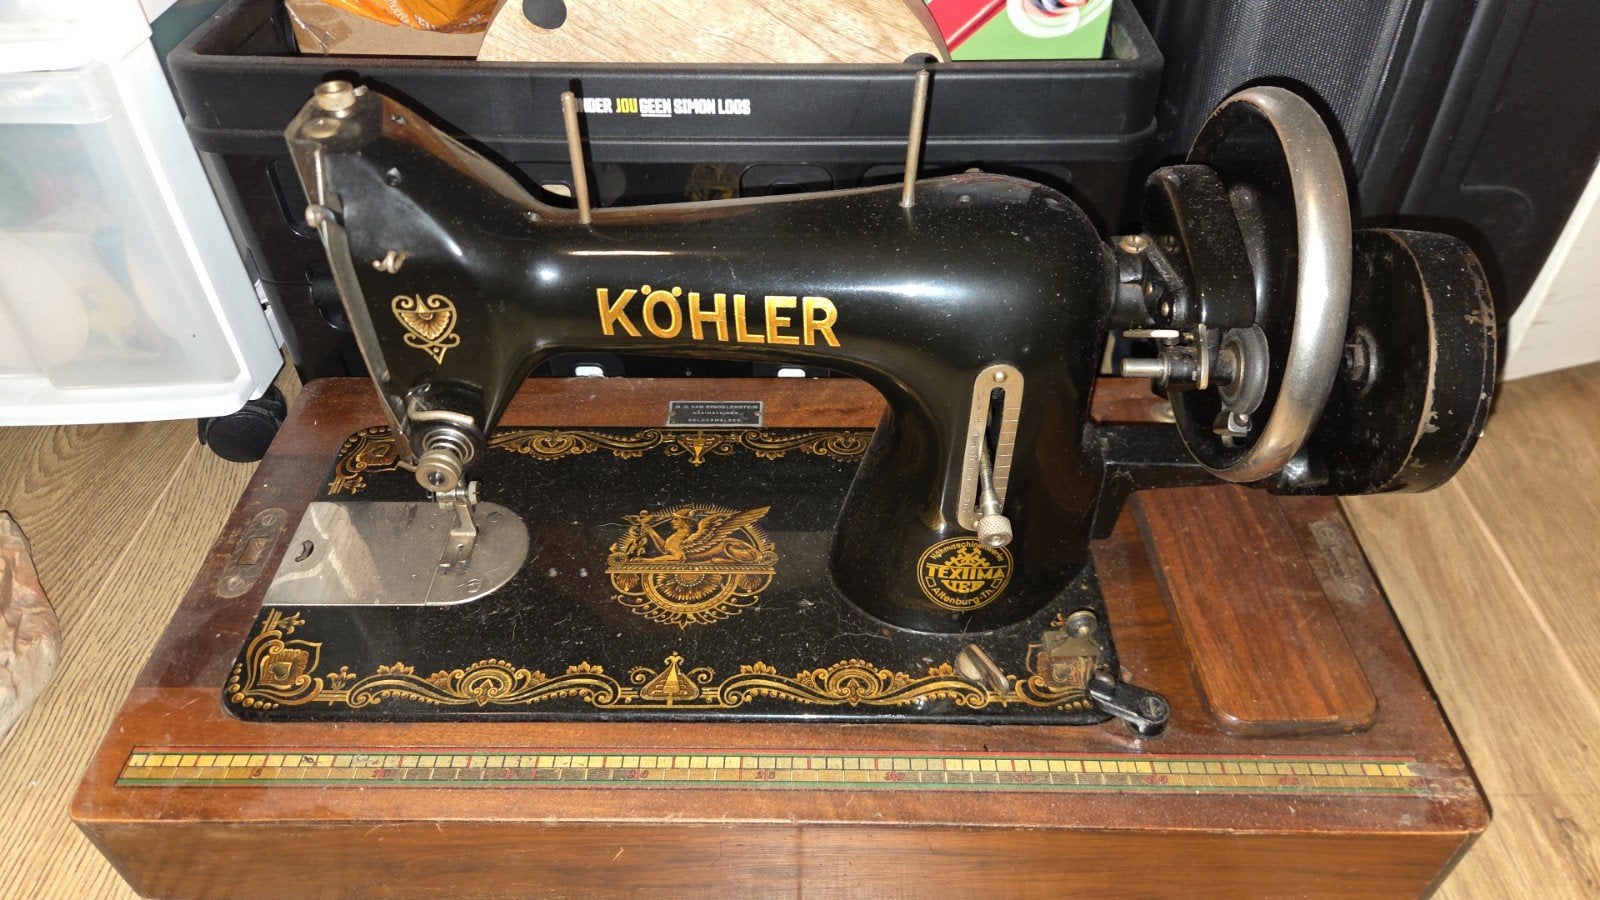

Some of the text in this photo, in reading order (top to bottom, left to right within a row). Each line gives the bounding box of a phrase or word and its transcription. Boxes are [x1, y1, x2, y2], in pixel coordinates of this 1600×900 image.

[616, 98, 638, 113] JOU
[639, 98, 672, 115] GEEN
[673, 98, 716, 115] SIMON
[717, 98, 751, 115] LOOS
[596, 284, 842, 348] KÖHLER
[926, 564, 1006, 580] TEXTIMA
